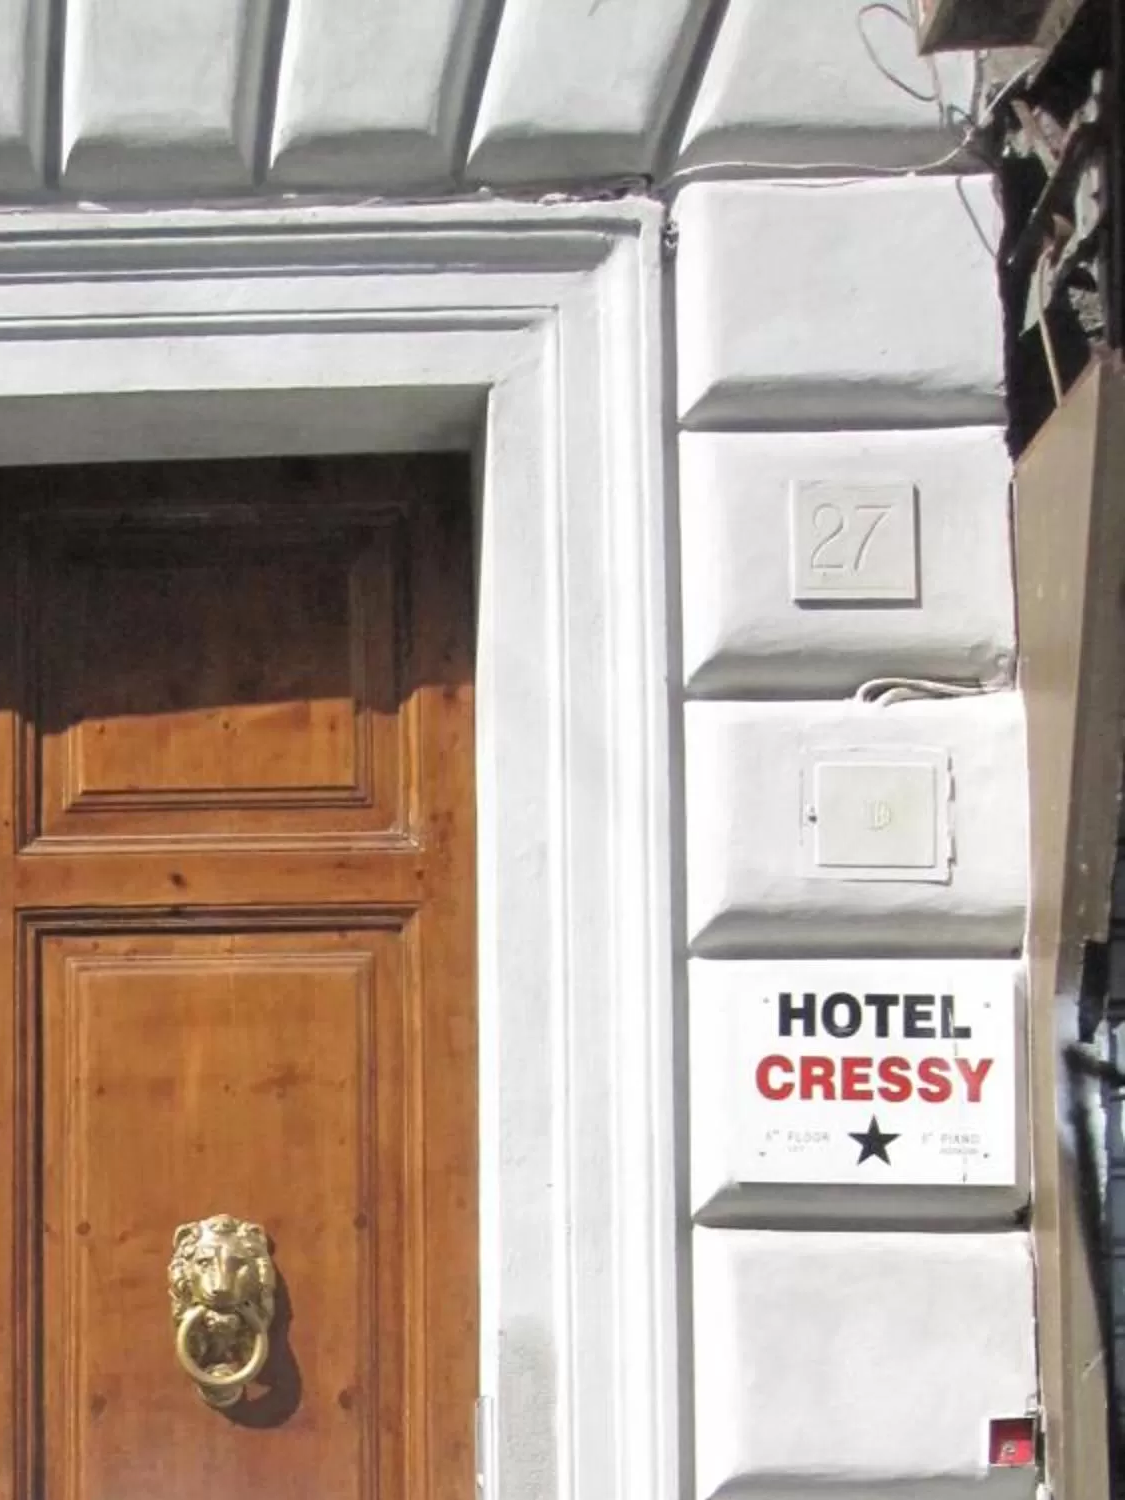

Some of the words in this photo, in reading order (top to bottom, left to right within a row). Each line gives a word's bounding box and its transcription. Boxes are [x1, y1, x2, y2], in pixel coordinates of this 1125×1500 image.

[811, 503, 892, 572] 27
[778, 991, 971, 1039] HOTEL
[755, 1054, 994, 1103] CRESSY
